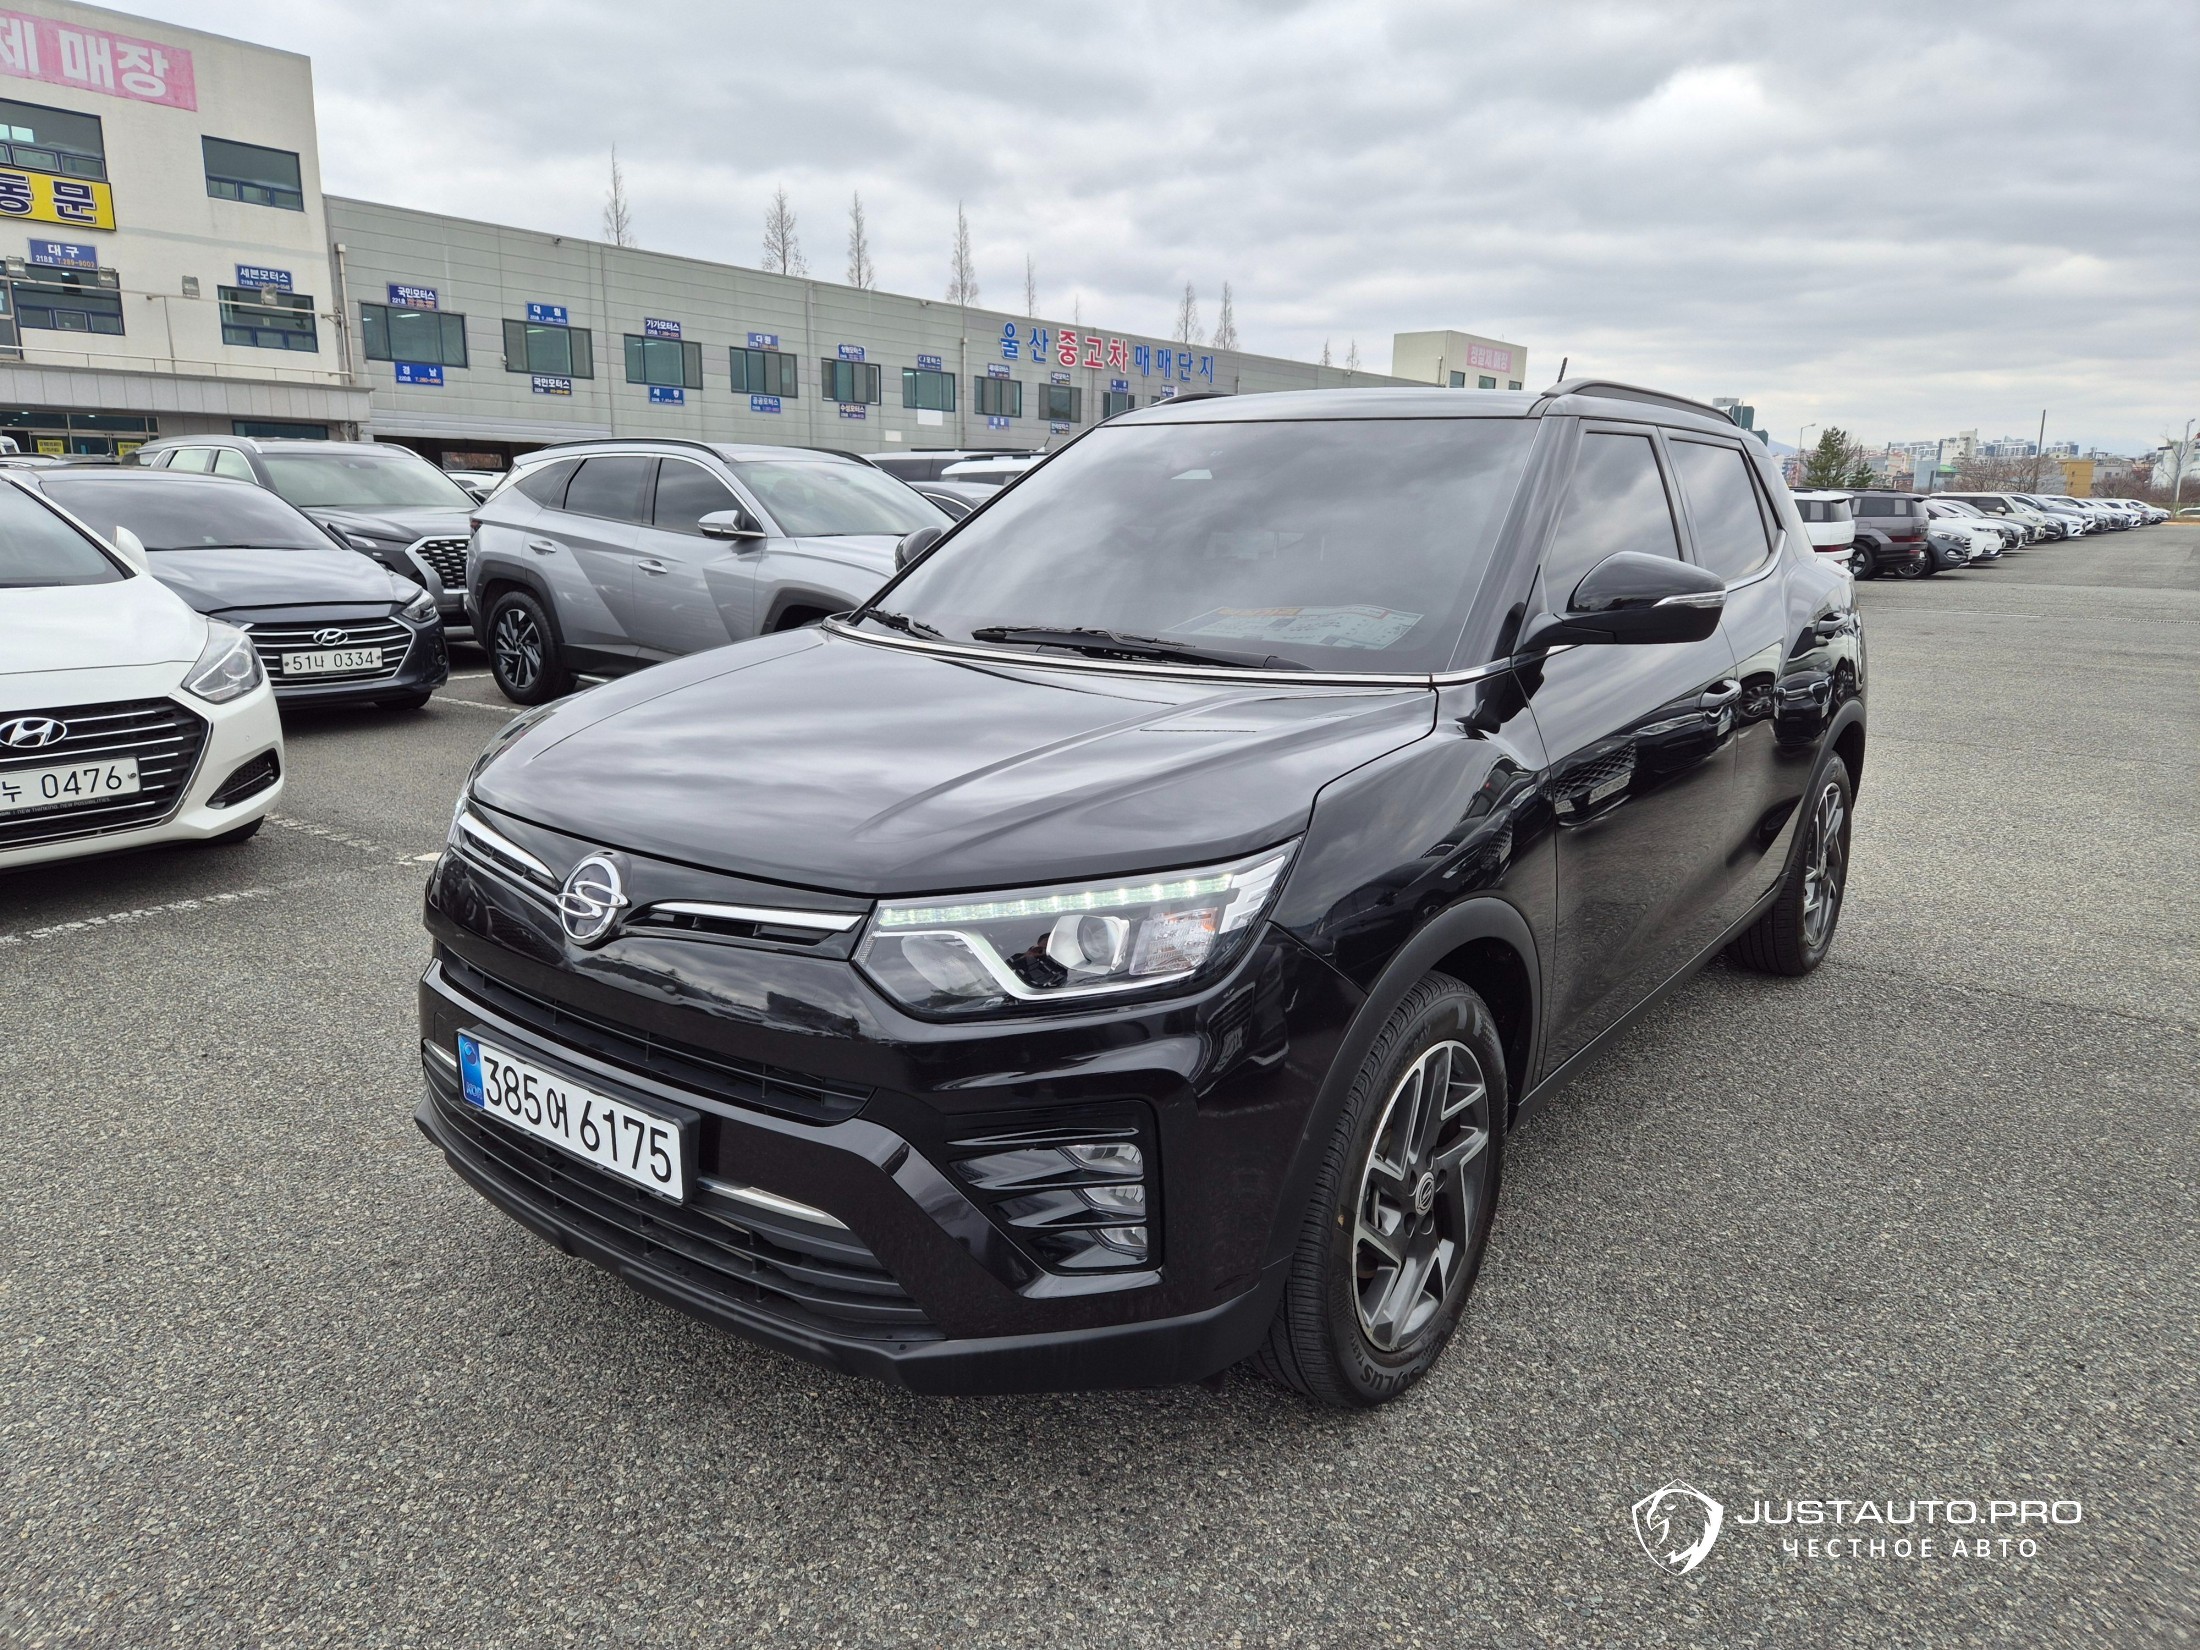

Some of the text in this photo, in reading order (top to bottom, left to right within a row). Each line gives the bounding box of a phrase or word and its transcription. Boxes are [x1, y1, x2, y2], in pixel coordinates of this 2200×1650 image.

[0, 16, 170, 97] 제 매장
[240, 267, 289, 283] 세븐모터스
[397, 286, 436, 300] 국민모터스
[646, 319, 680, 331] 가가모터스
[999, 321, 1214, 384] 울산 중고차 매매단지
[293, 651, 374, 671] 51나 0334
[41, 766, 122, 799] 0476
[466, 1081, 483, 1100] KOR
[483, 1055, 672, 1184] 385어 6175
